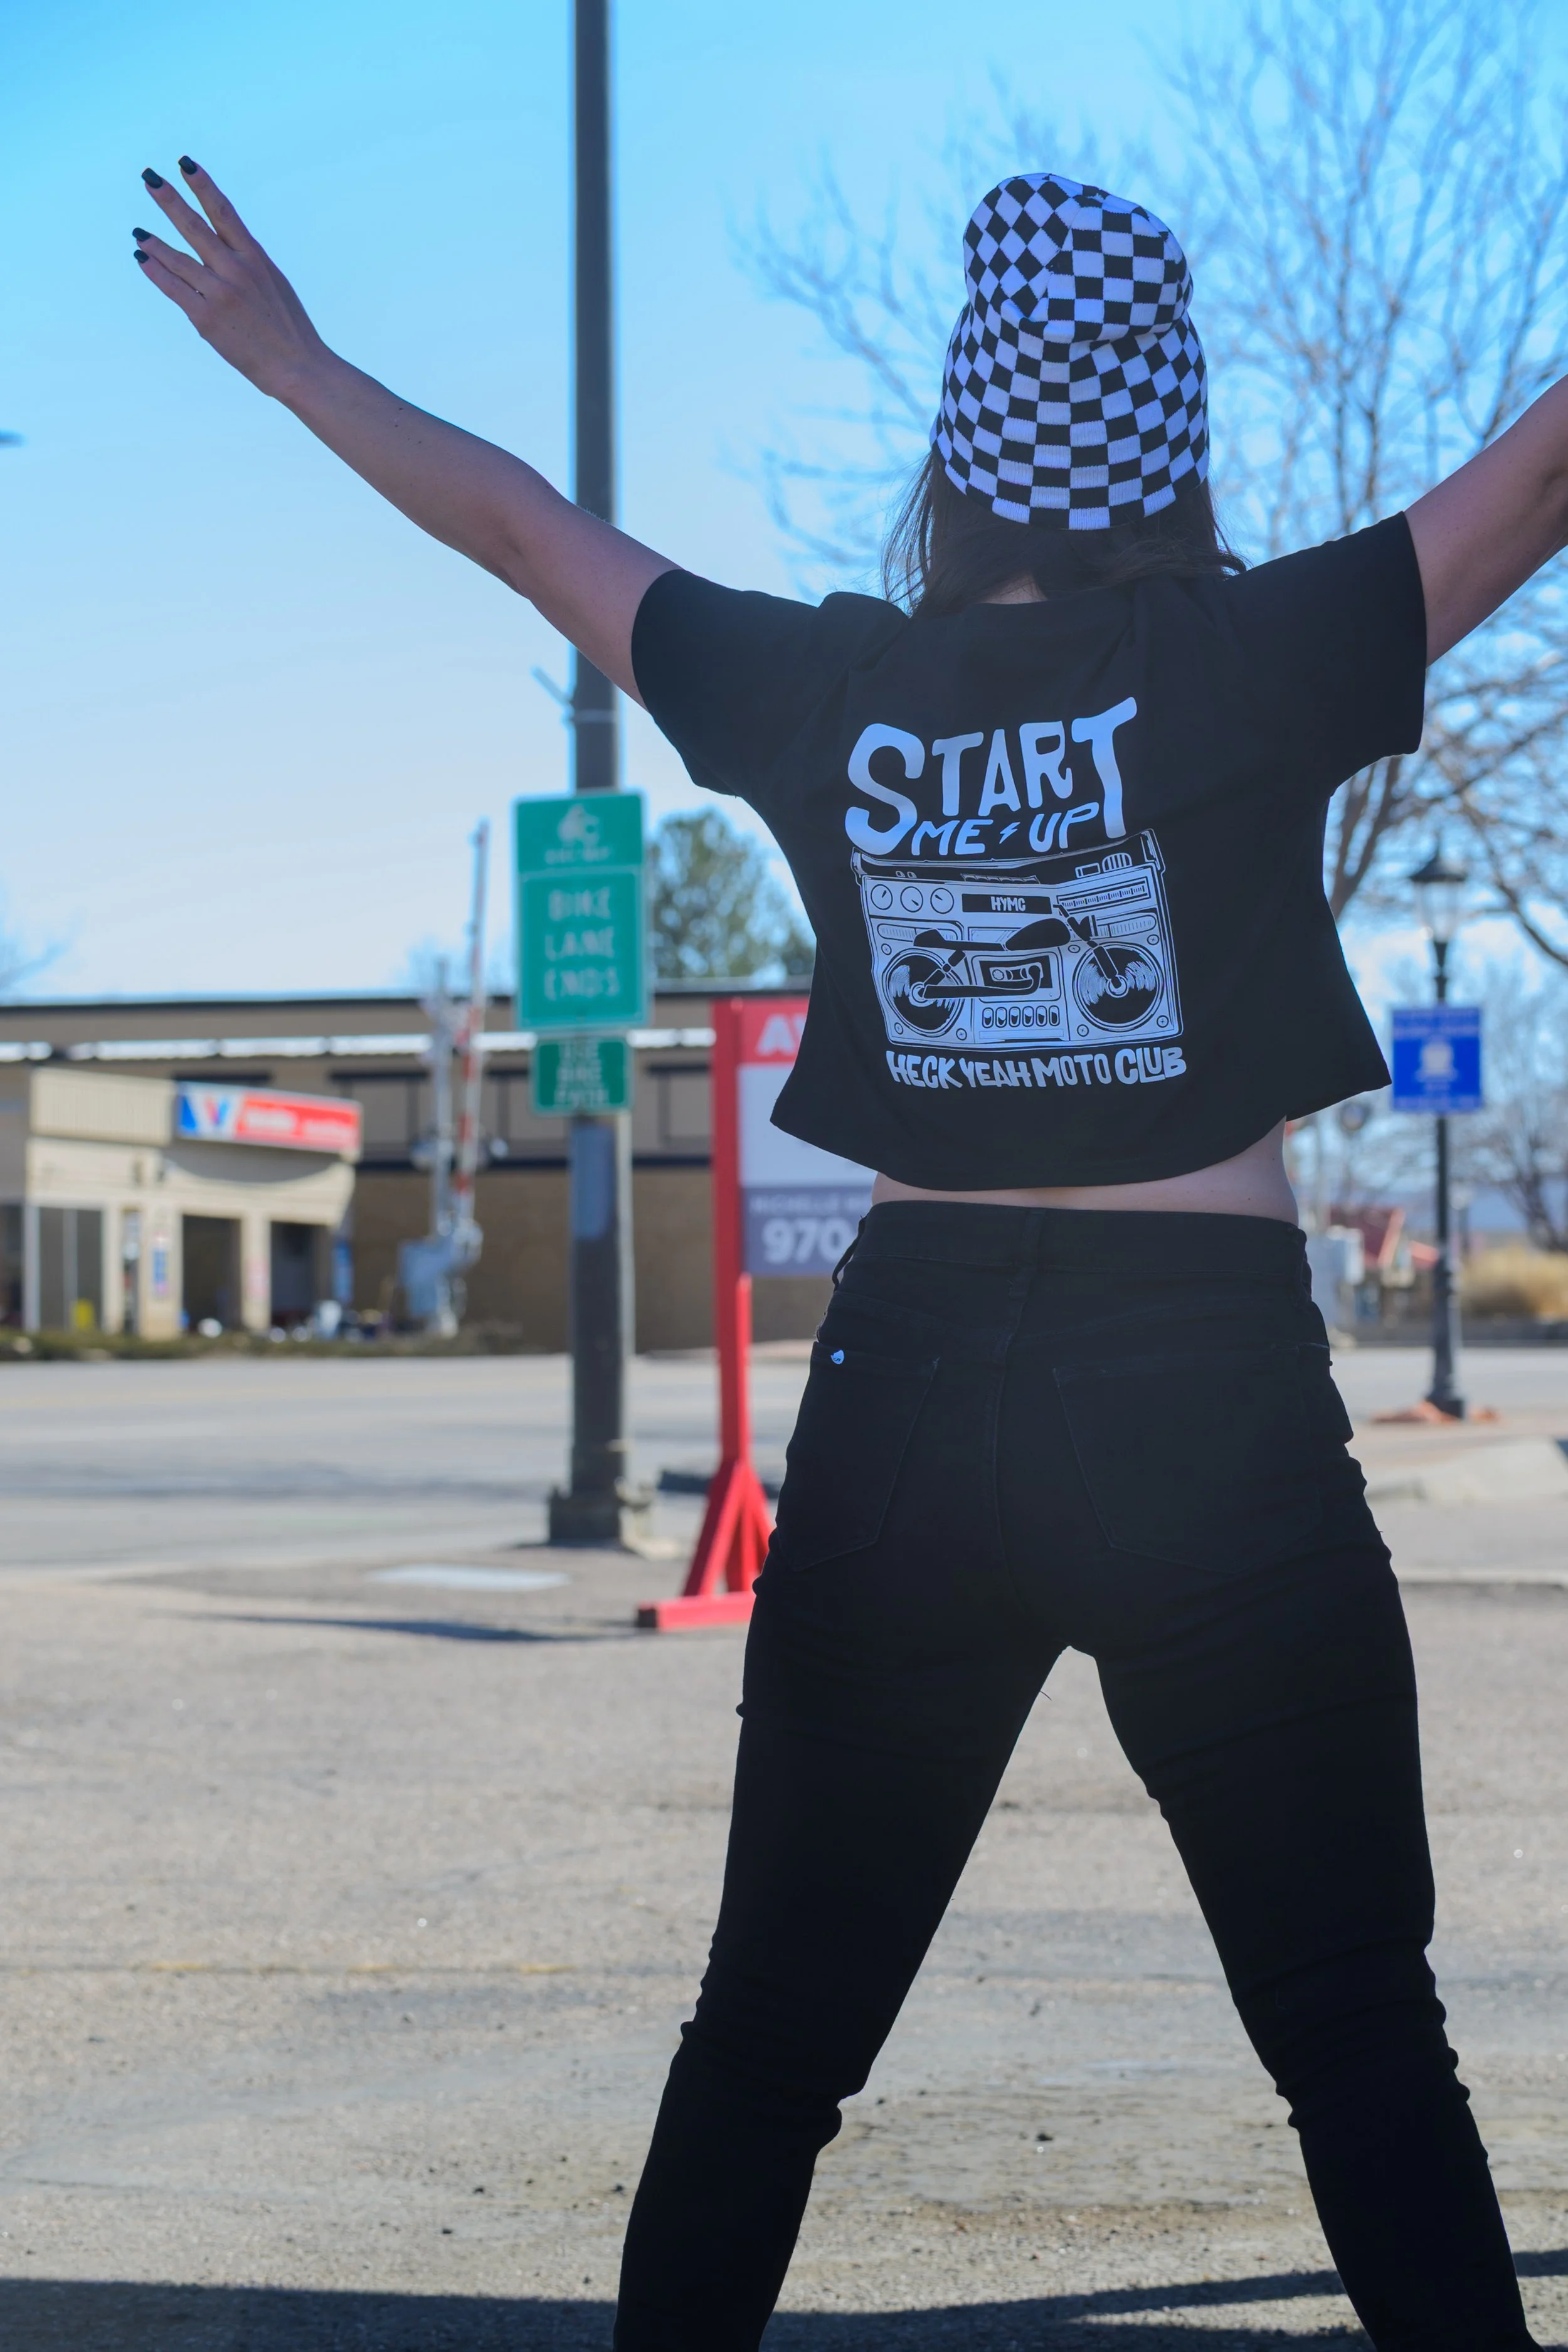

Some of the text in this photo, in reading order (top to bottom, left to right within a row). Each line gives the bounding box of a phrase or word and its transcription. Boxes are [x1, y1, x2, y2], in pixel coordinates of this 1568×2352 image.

[845, 697, 1137, 855] START
[911, 802, 1099, 855] ME UP
[548, 887, 612, 921] BIKE
[991, 896, 1026, 911] HYMC
[544, 926, 615, 961] LANE
[543, 966, 620, 1001] ENDS
[886, 1047, 1187, 1089] HECK YEAH MOTO CLUB
[763, 1217, 857, 1264] 970
